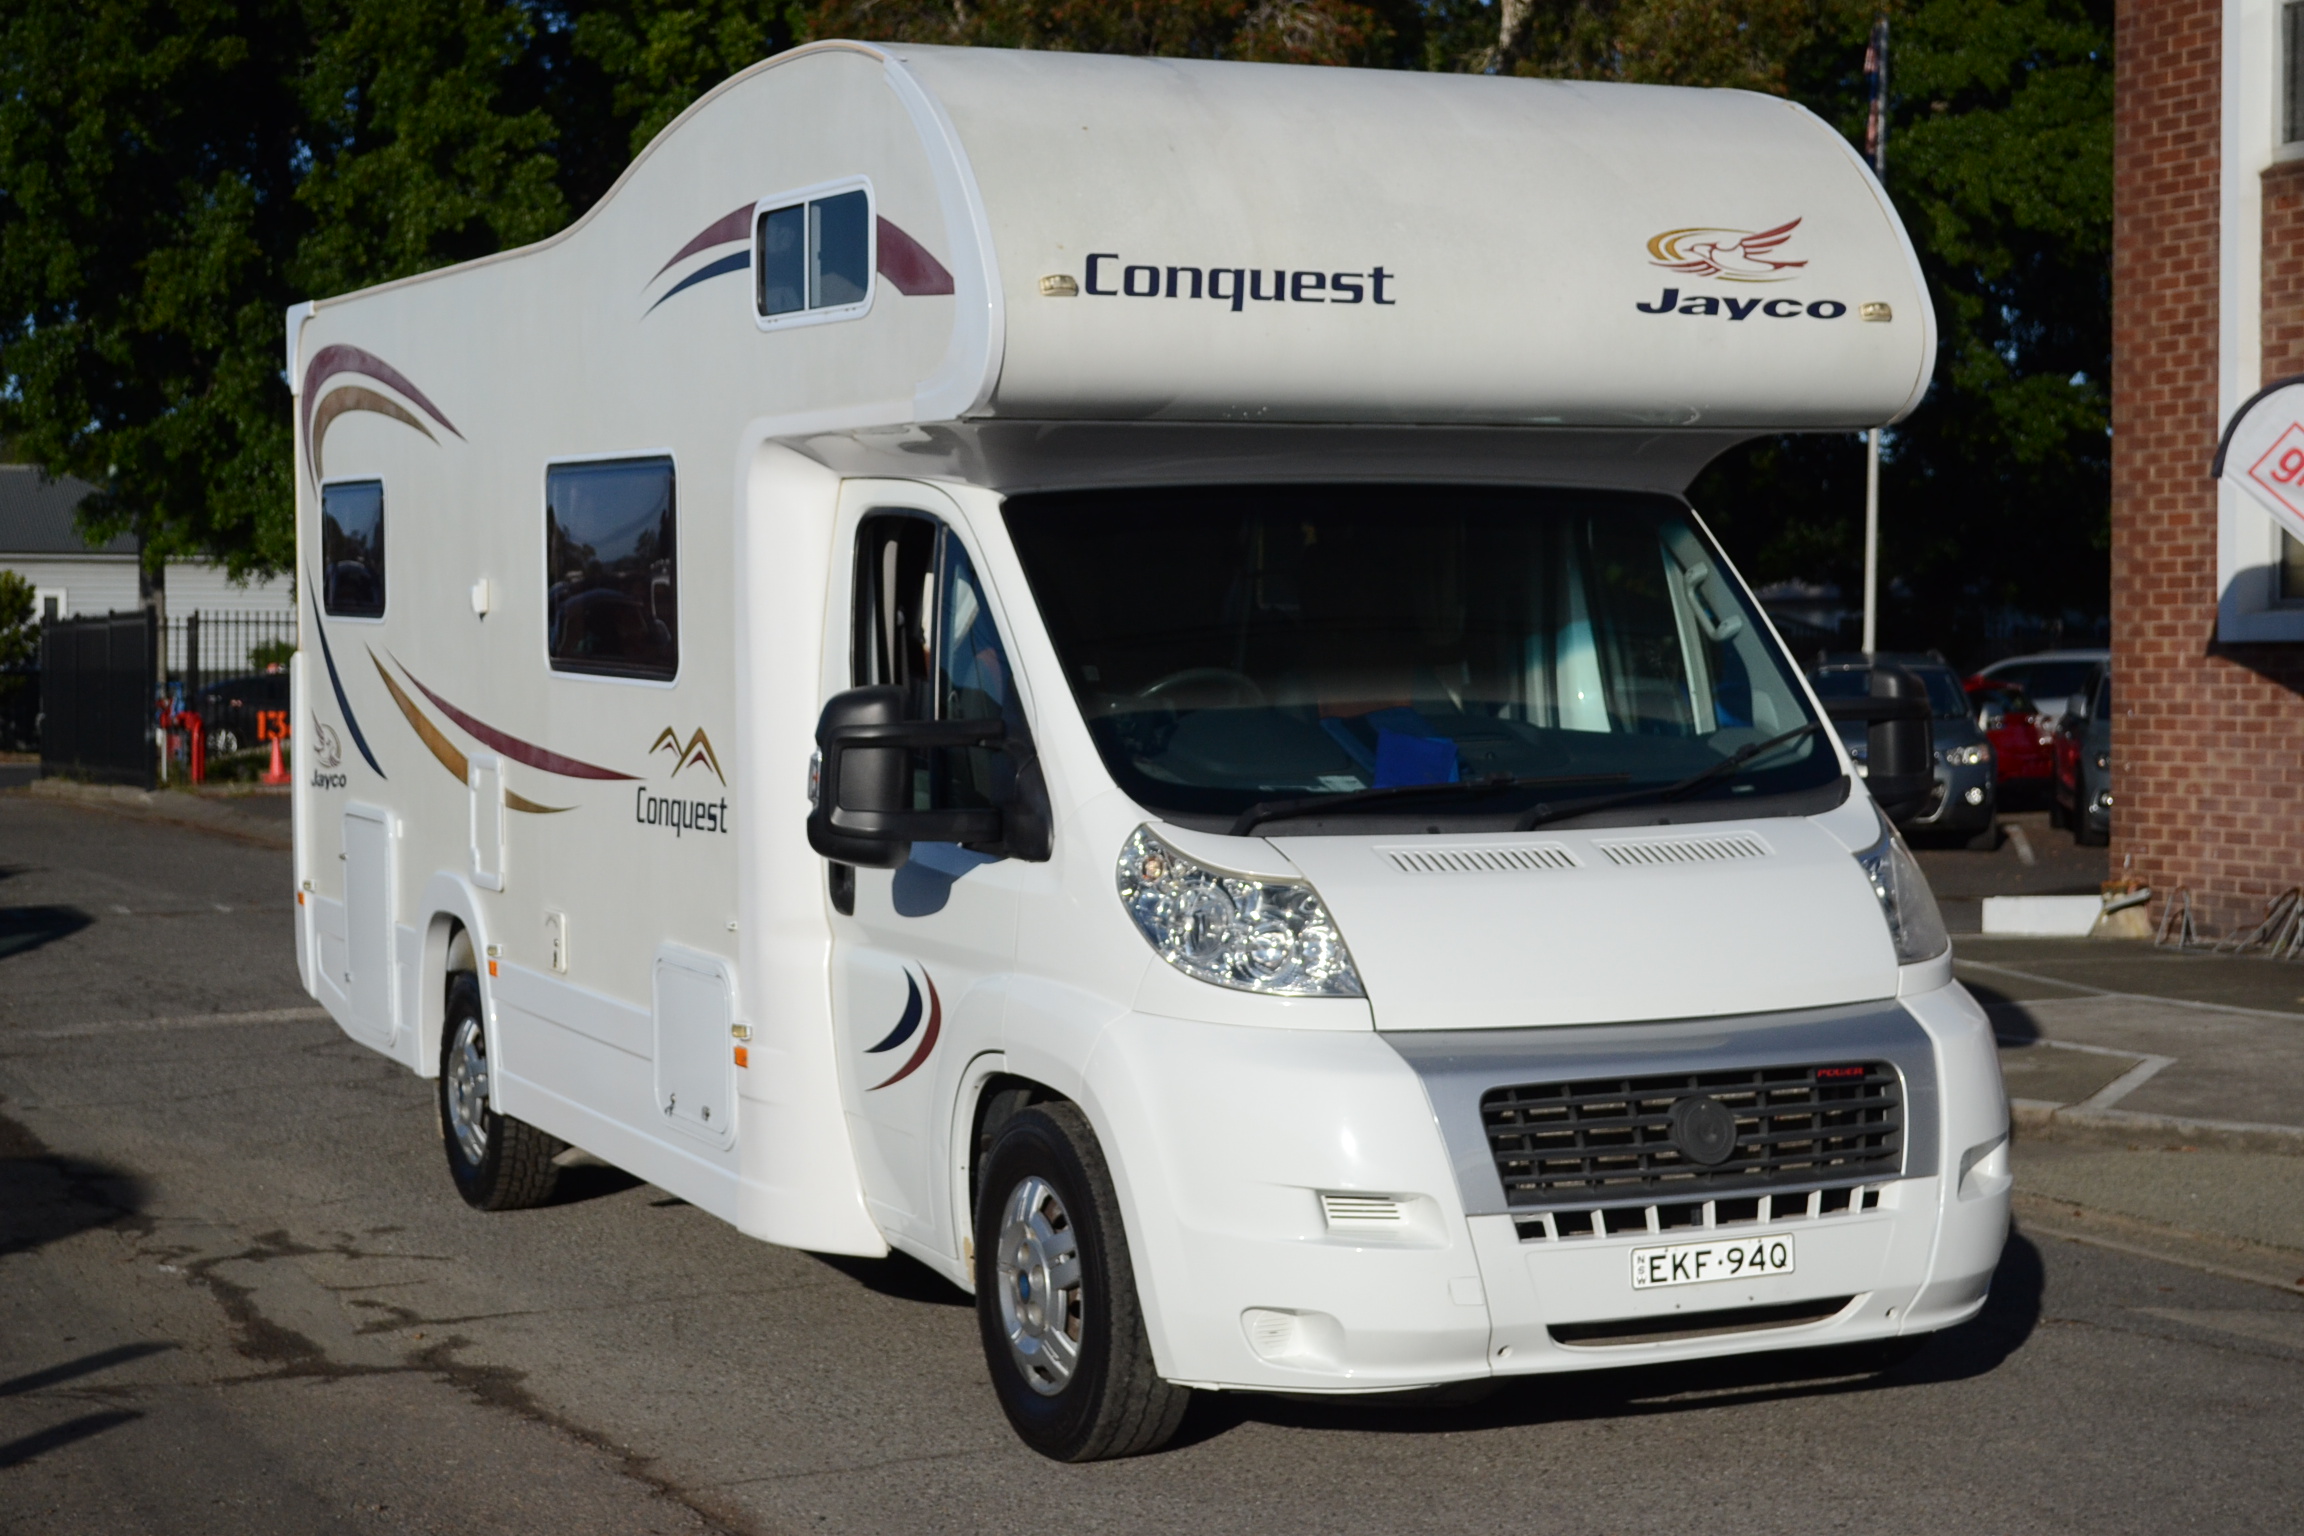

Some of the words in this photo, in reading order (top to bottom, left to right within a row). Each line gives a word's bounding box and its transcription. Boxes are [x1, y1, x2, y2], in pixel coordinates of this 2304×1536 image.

[1084, 253, 1396, 312] Conquest
[1636, 287, 1847, 321] Jayco
[311, 768, 347, 790] Jayco
[636, 786, 728, 838] Conquest
